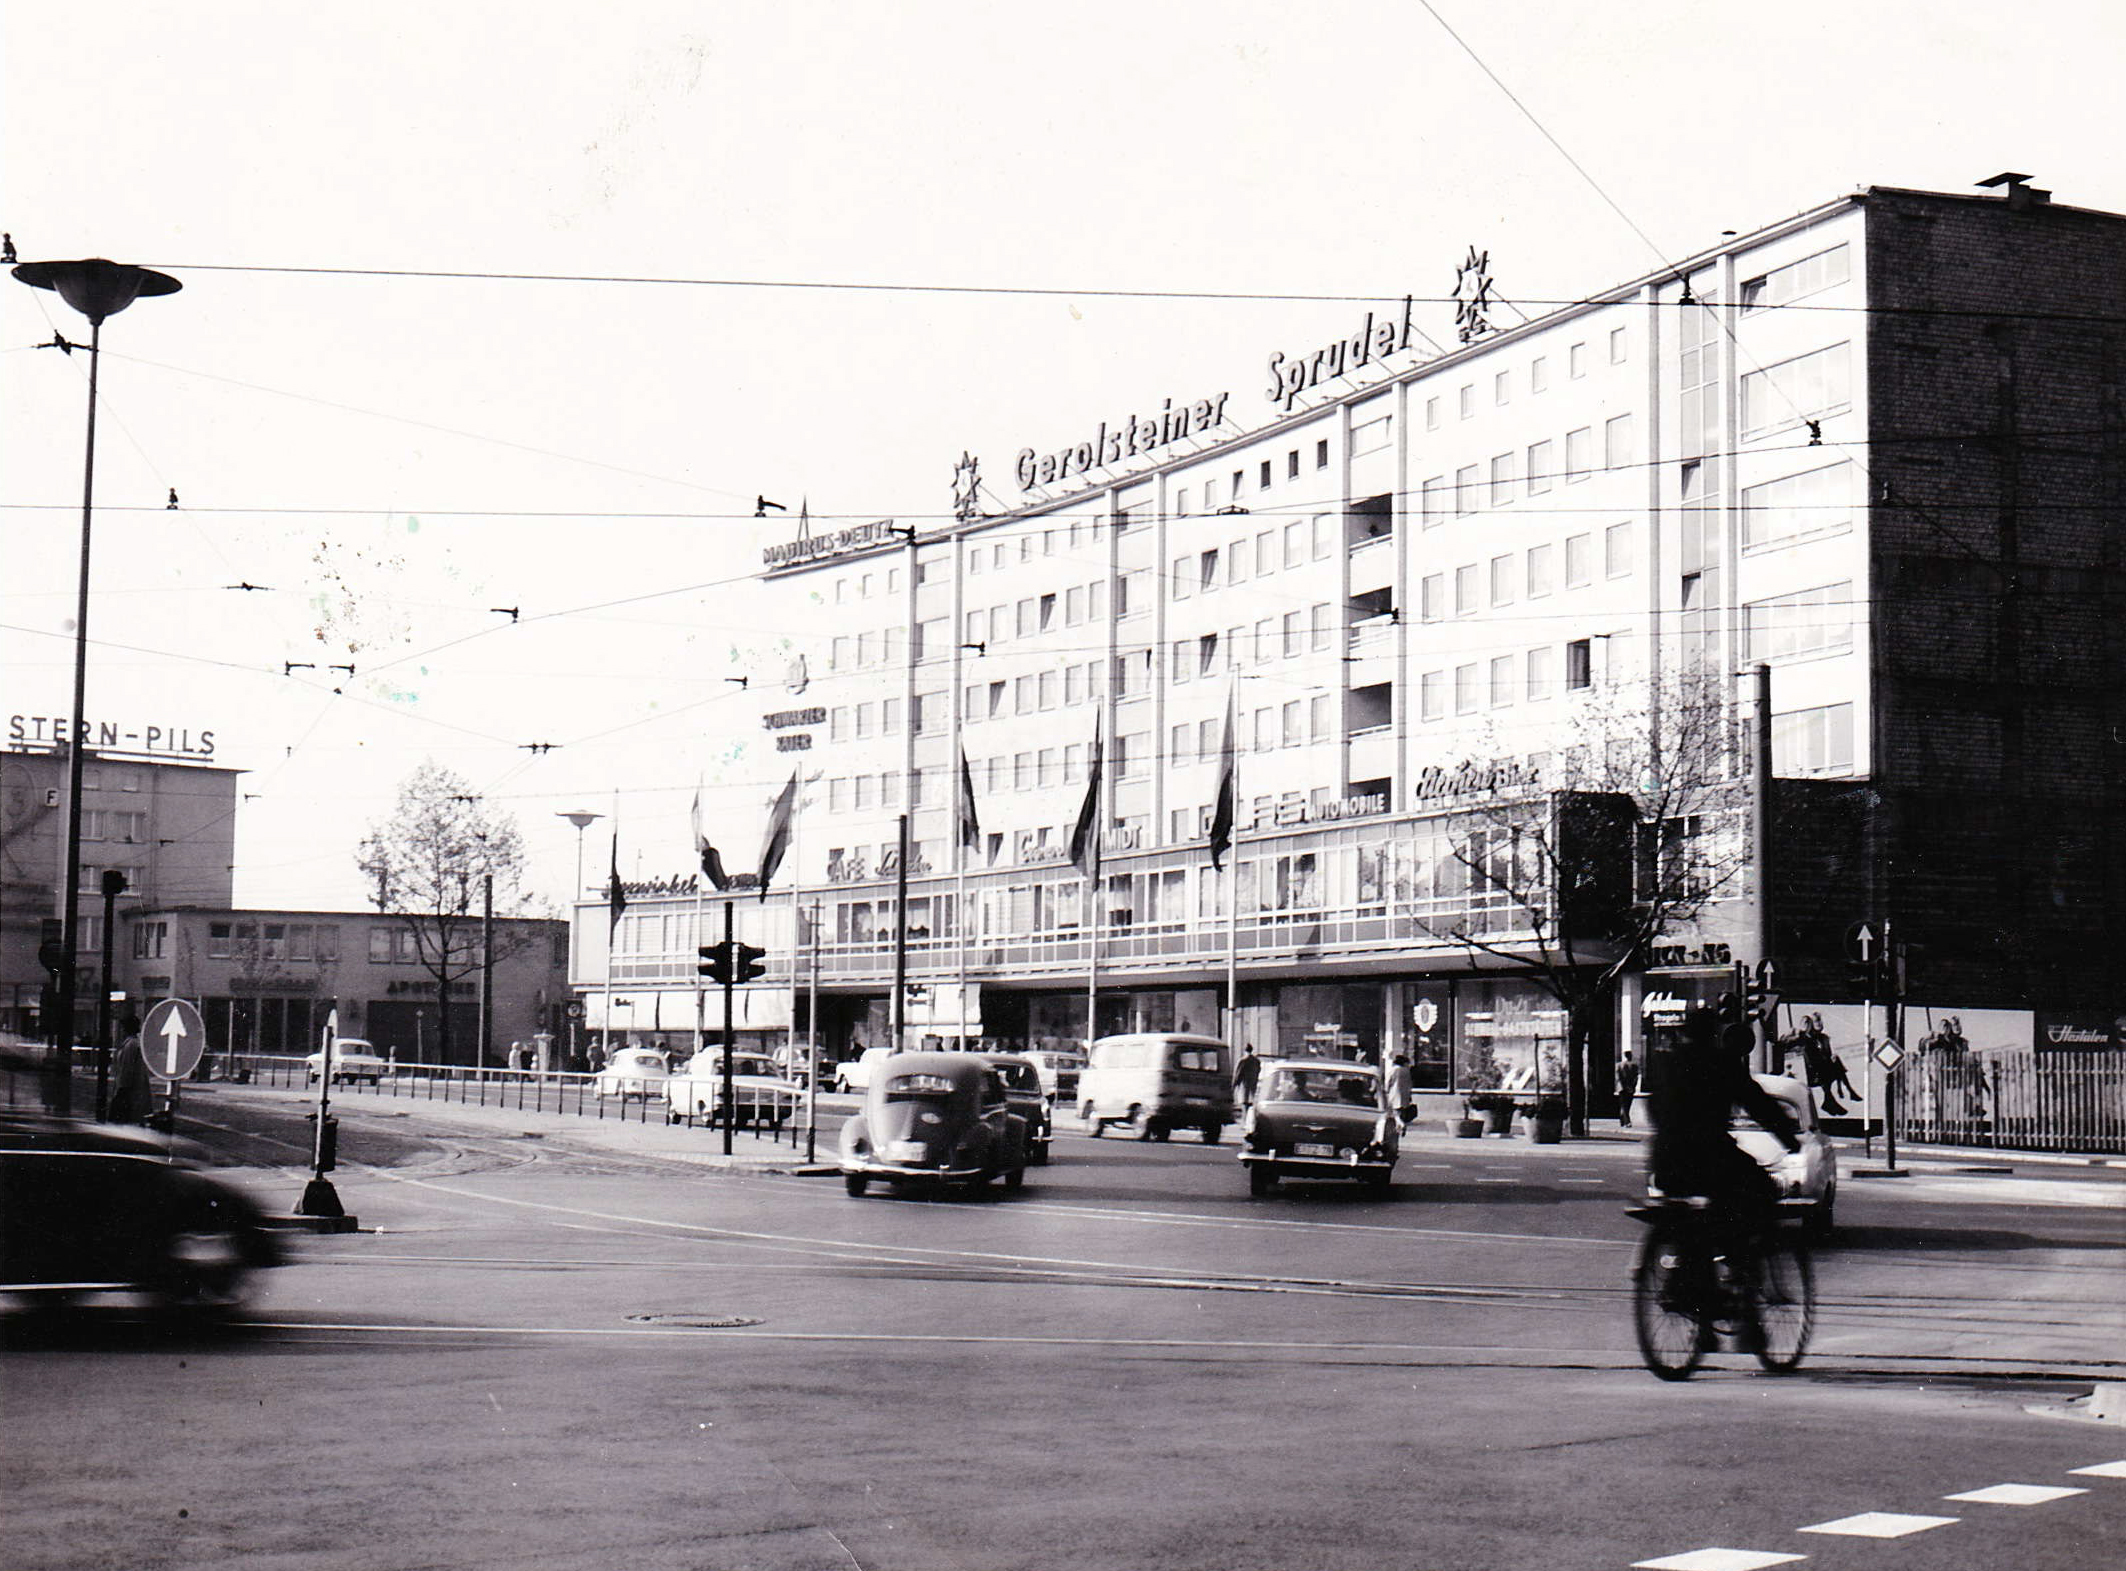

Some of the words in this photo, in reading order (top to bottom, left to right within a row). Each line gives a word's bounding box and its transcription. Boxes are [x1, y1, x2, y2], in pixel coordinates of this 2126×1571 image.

[1014, 392, 1229, 490] Gerolsteiner
[1266, 294, 1412, 411] Sprudel
[762, 518, 894, 565] MAGIRUS-DEUTZ
[8, 714, 215, 755] STERN-PILS
[1305, 793, 1386, 821] AUTOMOBILE
